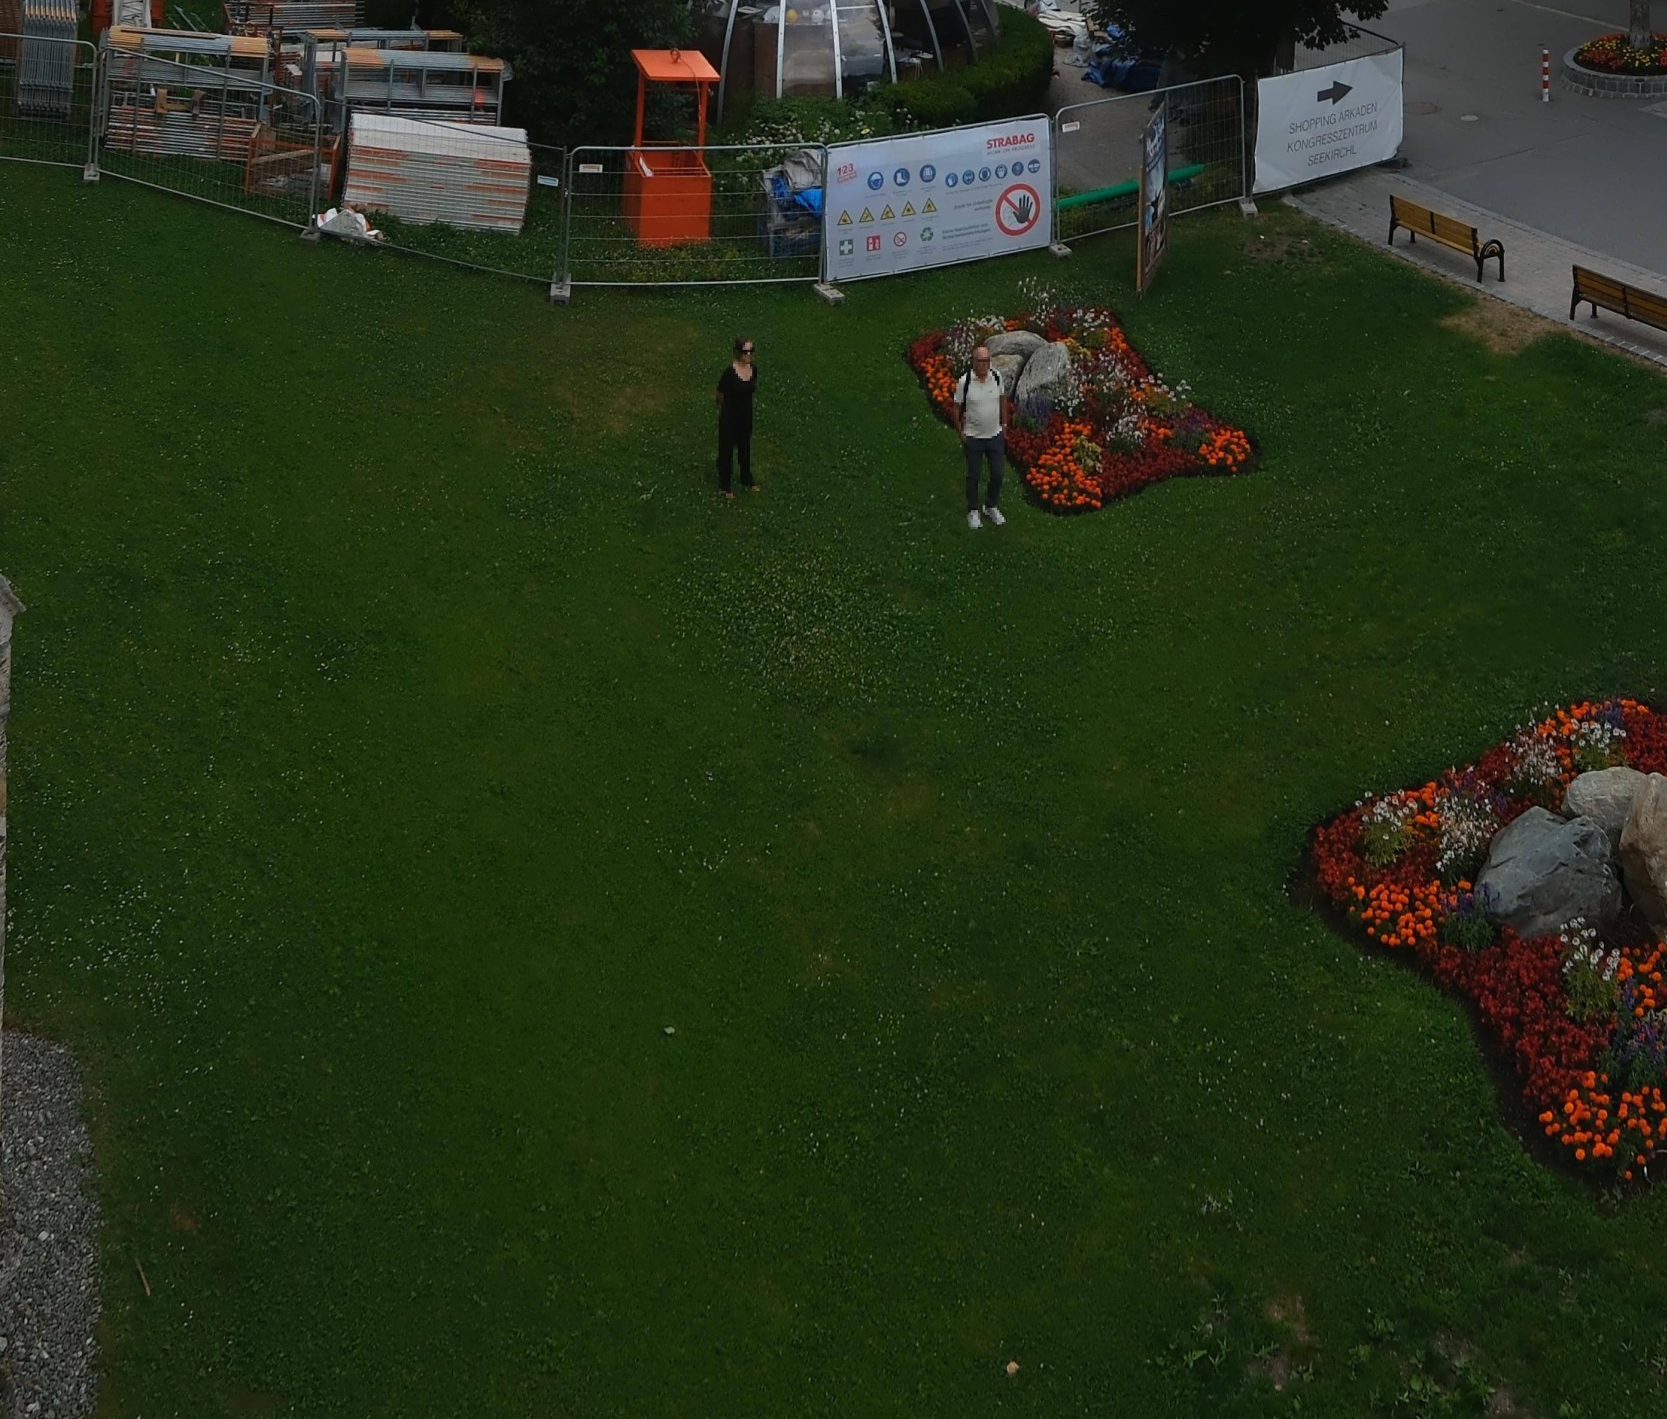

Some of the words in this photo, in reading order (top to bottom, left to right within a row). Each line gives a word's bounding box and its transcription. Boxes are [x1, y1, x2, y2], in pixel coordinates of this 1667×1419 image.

[1288, 113, 1336, 135] SHOPPING
[1338, 102, 1378, 123] ARKADEN
[986, 133, 1036, 150] STRABAG
[1286, 120, 1378, 154] KONGRESSZENTRUM
[1307, 144, 1358, 167] SEEKIRCHL
